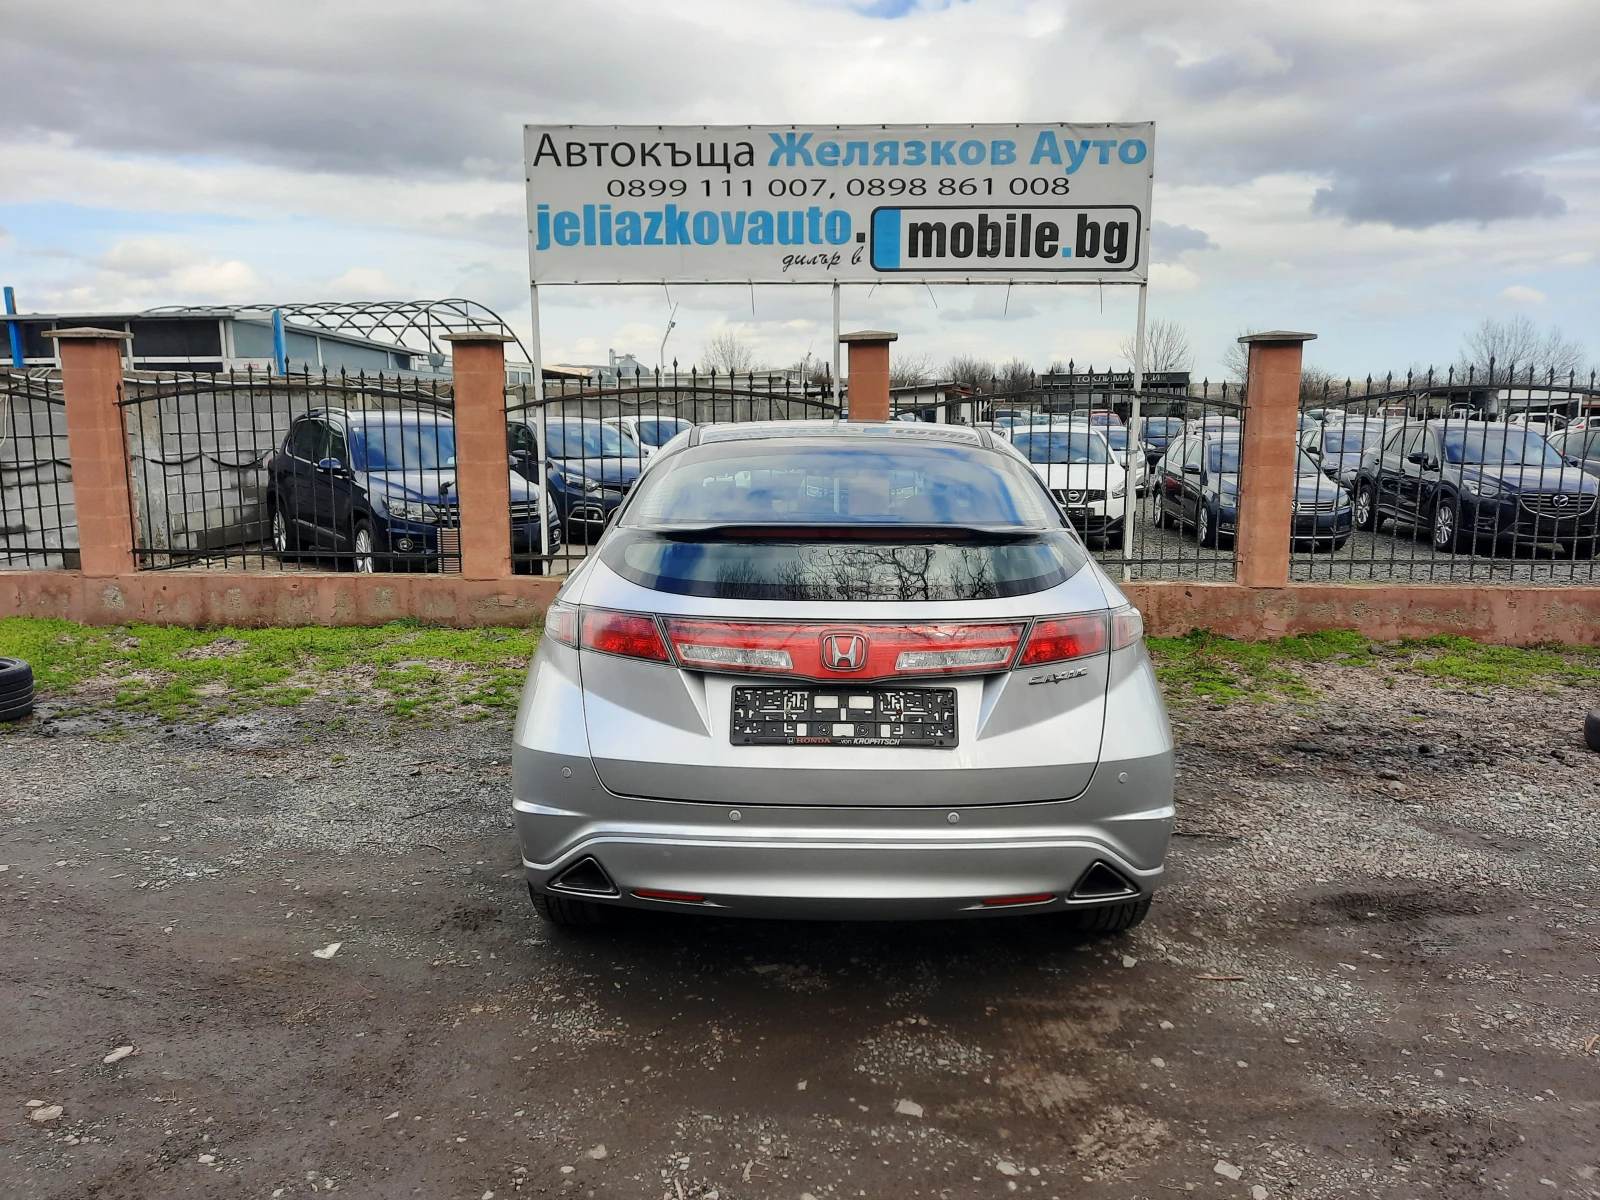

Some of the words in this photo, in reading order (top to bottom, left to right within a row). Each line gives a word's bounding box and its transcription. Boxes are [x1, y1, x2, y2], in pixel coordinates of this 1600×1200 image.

[533, 132, 755, 174] Автокъща
[767, 132, 1017, 167] Желязков
[1029, 130, 1147, 175] Ауто
[606, 178, 688, 198] 0899
[700, 178, 753, 197] 111
[767, 178, 835, 200] 007,
[846, 177, 927, 197] 0898
[937, 177, 994, 196] 861
[1008, 176, 1071, 196] 008
[536, 203, 866, 250] jeliazkovauto.
[908, 213, 1129, 264] mobile.bg
[782, 251, 841, 273] дилър
[1029, 667, 1089, 685] CIVIC
[853, 737, 901, 746] KROPFITSCH
